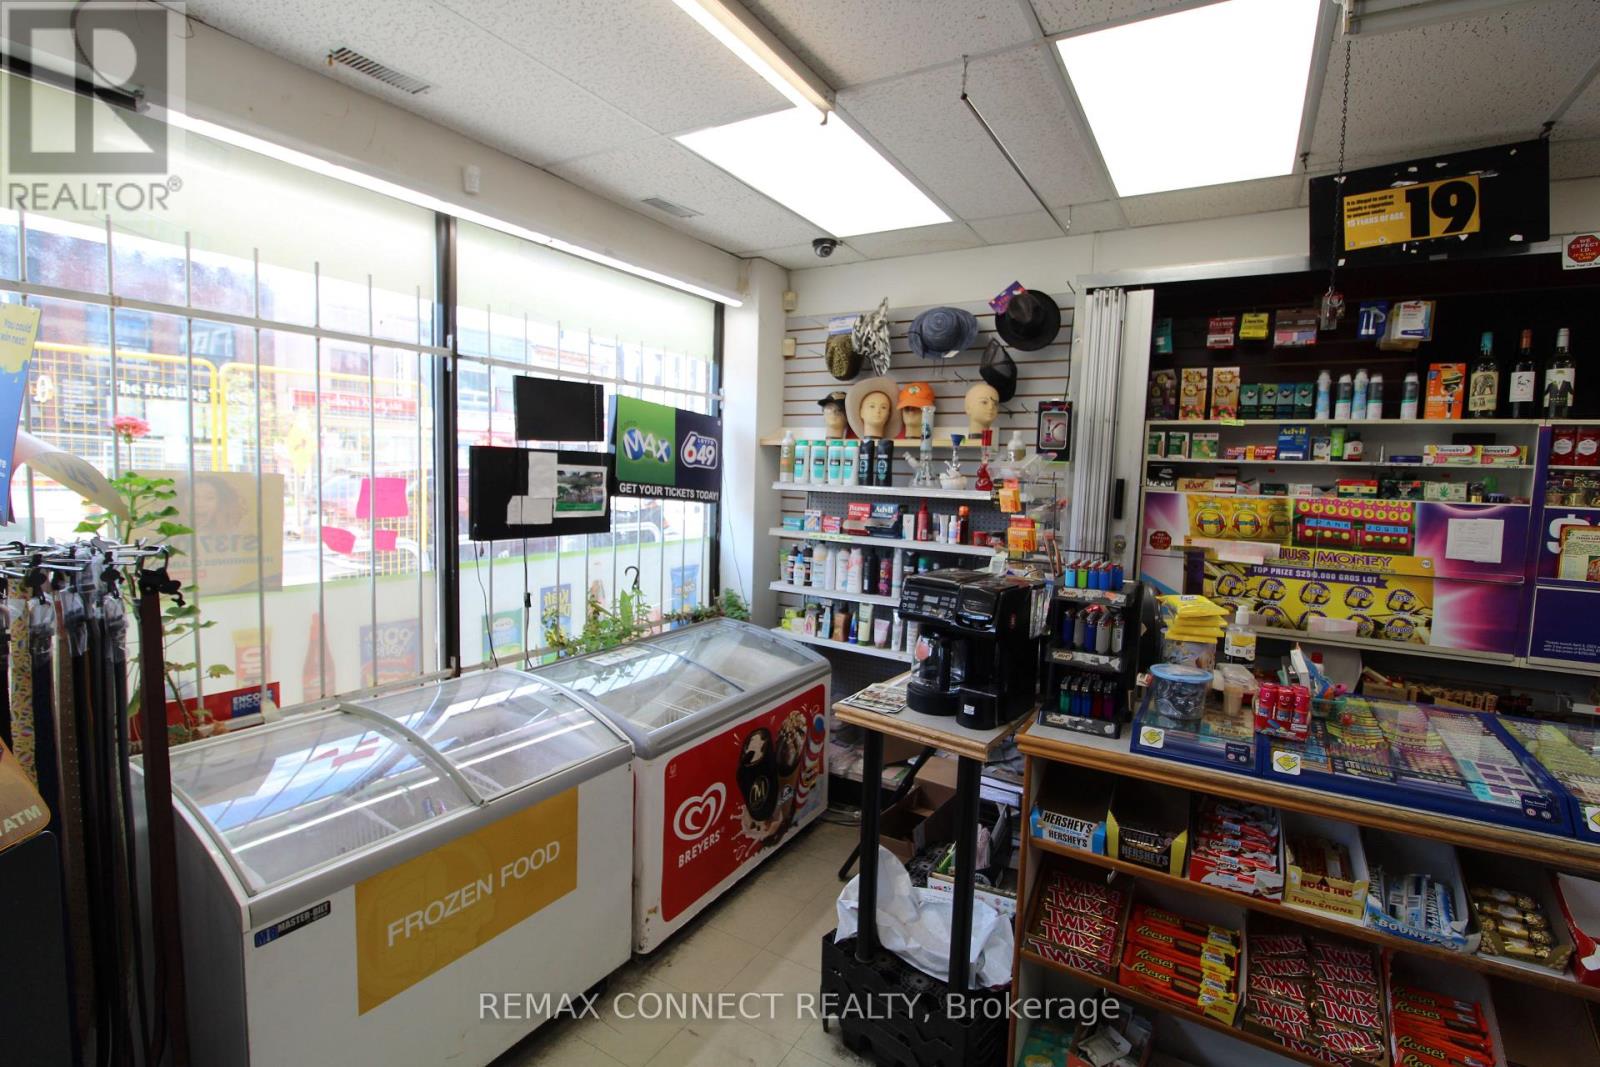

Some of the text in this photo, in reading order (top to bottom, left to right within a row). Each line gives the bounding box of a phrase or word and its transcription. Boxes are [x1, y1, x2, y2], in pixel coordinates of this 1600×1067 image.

[1405, 181, 1477, 238] 19
[1281, 426, 1307, 435] Advil
[623, 428, 671, 464] MAX
[619, 482, 721, 501] GET YOUR TICKETS TODAY!
[874, 505, 894, 514] Advil
[1316, 551, 1393, 567] MONEY
[1253, 566, 1269, 574] TOP
[1270, 567, 1293, 576] PRIZE
[1362, 576, 1378, 584] LOT
[232, 690, 276, 705] ENCOE
[1043, 811, 1093, 834] HERSHEY'S
[678, 831, 721, 869] BREYERS
[1048, 830, 1088, 848] HERSHEY'S
[387, 840, 561, 947] FROZEN FOOD
[1048, 885, 1103, 915] TWIX
[1292, 895, 1355, 914] TOBLERONE
[1044, 902, 1101, 936] TWIX
[1378, 919, 1438, 943] BOUNTY
[1040, 920, 1098, 952] TWIX
[1028, 937, 1102, 976] TWIX
[1136, 949, 1175, 969] Reese's
[1251, 957, 1311, 977] TWIX
[1130, 962, 1172, 983] Reese's
[1315, 960, 1377, 985] TWIX
[1314, 979, 1378, 1009] TWIX
[1248, 993, 1311, 1025] TWIX
[1317, 996, 1382, 1029] TWIX
[1395, 1000, 1441, 1020] Reese's
[1398, 1034, 1447, 1060] Reese's
